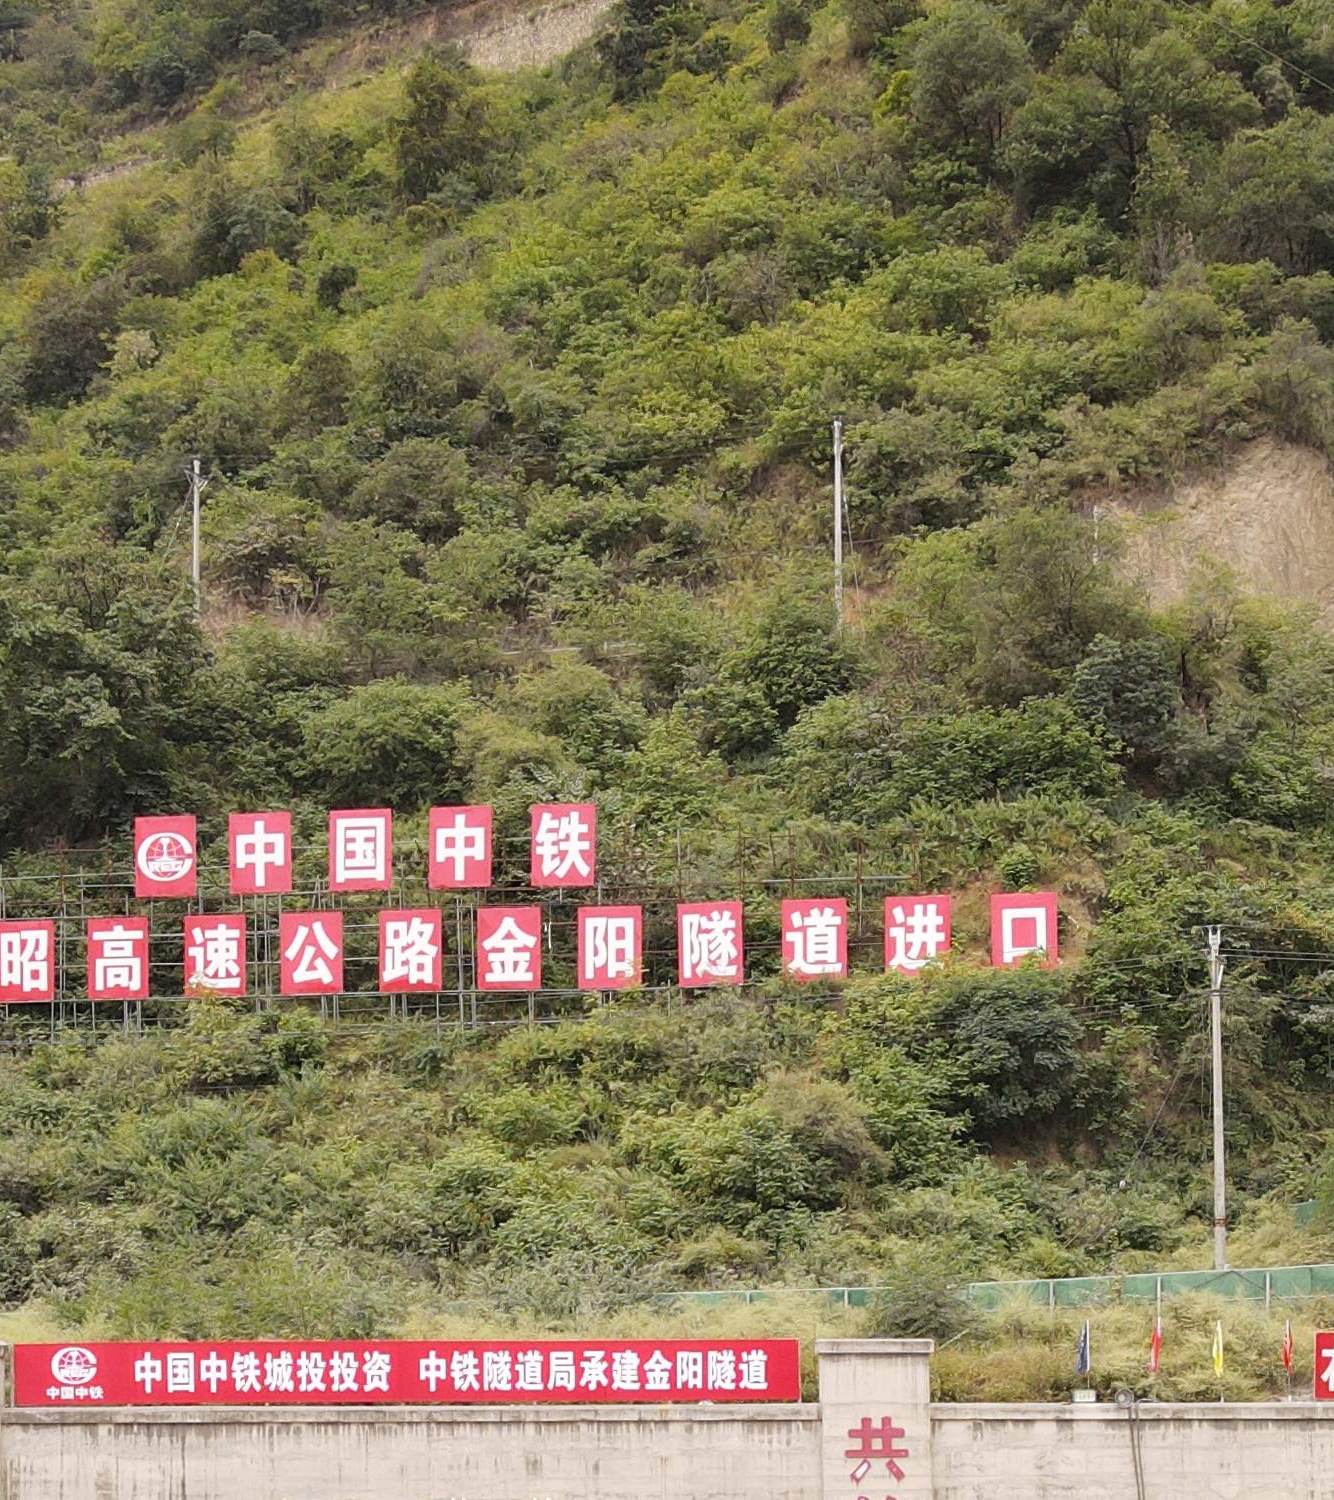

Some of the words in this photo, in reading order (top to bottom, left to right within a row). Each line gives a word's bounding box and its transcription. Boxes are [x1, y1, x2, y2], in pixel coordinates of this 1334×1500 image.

[235, 810, 595, 887] 中国中铁
[134, 1350, 391, 1393] 中国中铁城投投资
[419, 1349, 768, 1392] 中铁隧道局承建金阳隧道
